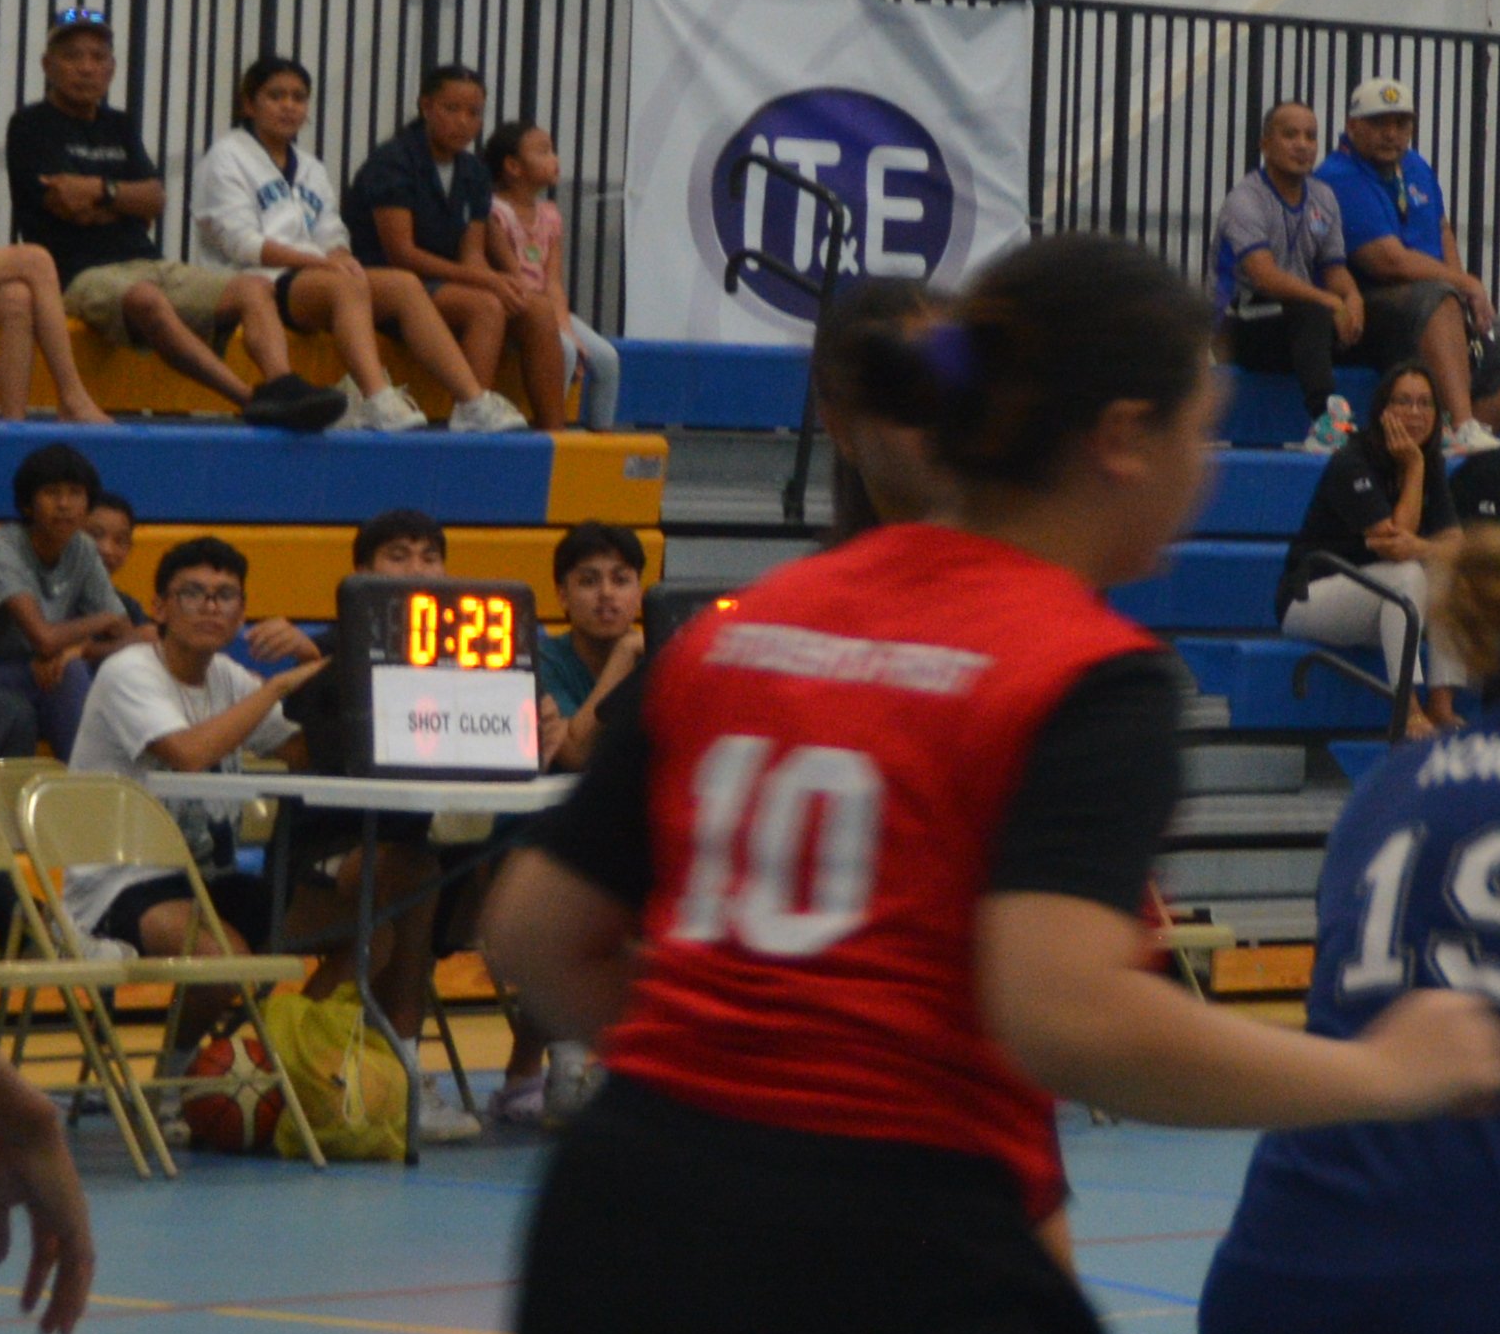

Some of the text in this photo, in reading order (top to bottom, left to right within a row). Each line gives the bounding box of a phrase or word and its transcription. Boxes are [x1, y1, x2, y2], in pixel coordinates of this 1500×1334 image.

[408, 592, 514, 669] 0:23
[408, 709, 512, 736] SHOT CLOCK
[666, 733, 885, 958] 10
